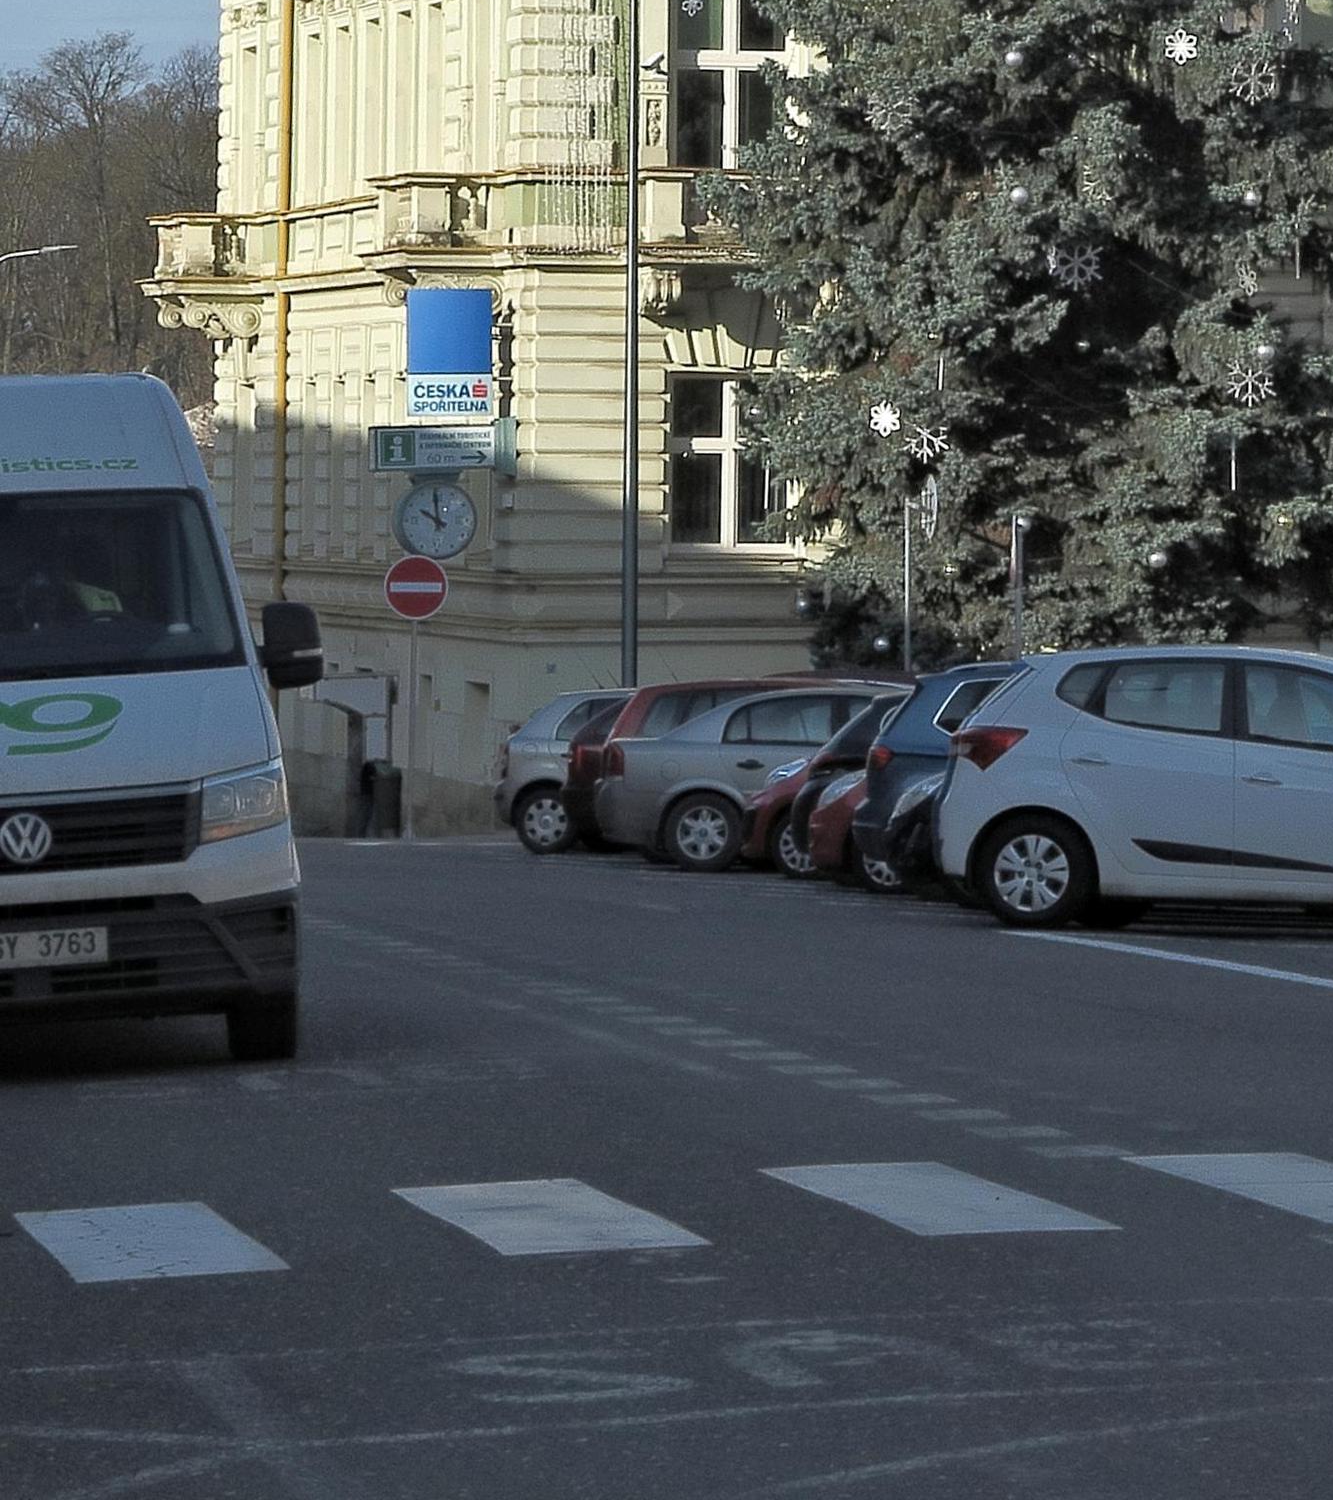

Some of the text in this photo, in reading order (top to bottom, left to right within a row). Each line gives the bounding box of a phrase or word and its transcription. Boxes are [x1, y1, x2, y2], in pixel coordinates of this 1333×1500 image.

[413, 382, 470, 399] ČESKÁ
[413, 399, 488, 412] SPOŘITELNA
[38, 930, 96, 958] 3763
